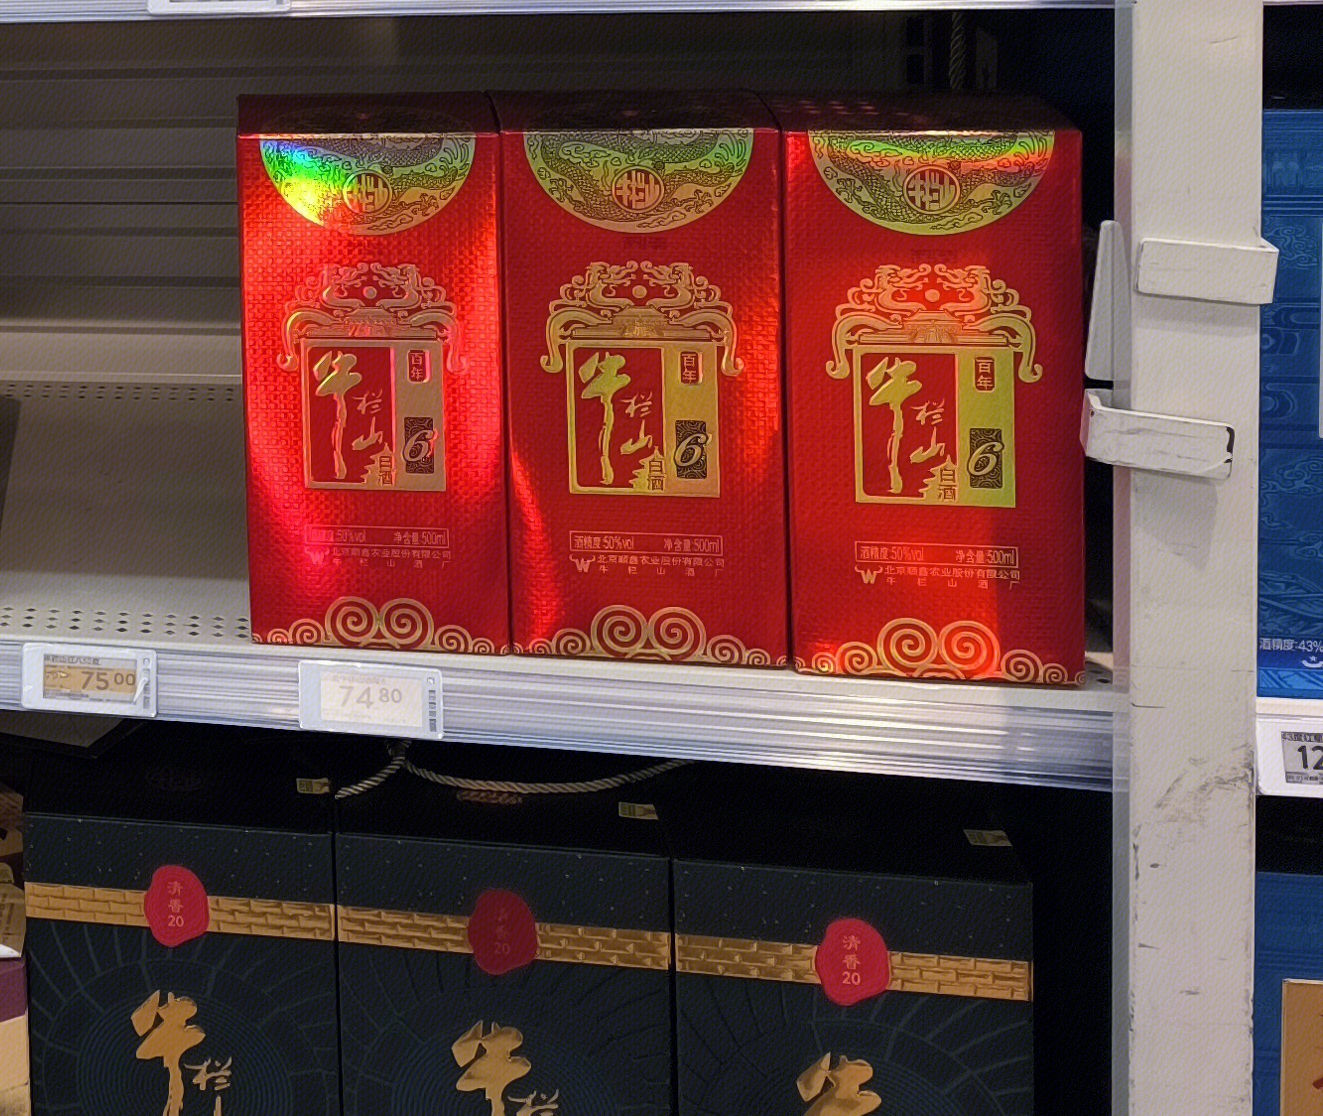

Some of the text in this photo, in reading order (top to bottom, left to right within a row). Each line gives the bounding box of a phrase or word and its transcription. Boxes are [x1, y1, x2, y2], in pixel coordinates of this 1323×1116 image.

[867, 357, 947, 494] 牛栏山
[966, 440, 1005, 477] 6
[842, 972, 862, 987] 20
